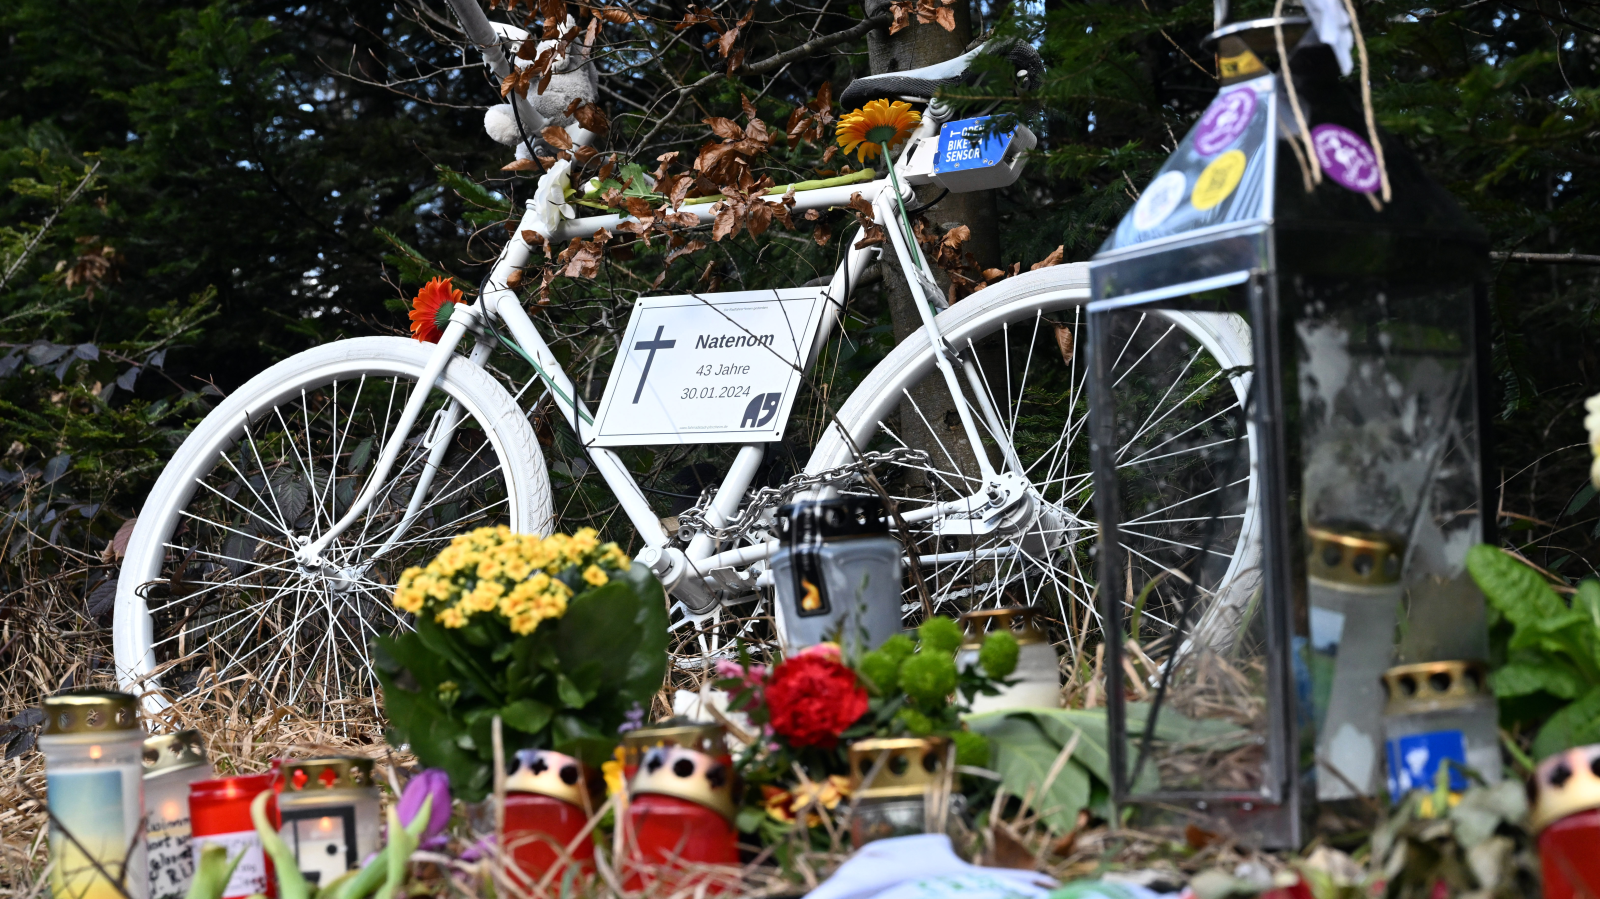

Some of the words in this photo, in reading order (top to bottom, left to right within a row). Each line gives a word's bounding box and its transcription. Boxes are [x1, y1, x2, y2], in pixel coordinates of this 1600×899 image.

[947, 139, 968, 151] BIKE
[945, 149, 980, 162] SENSOR
[695, 334, 774, 349] Natenom
[696, 364, 712, 376] 43
[715, 363, 750, 376] Jahre
[681, 386, 751, 399] 30.01.2024
